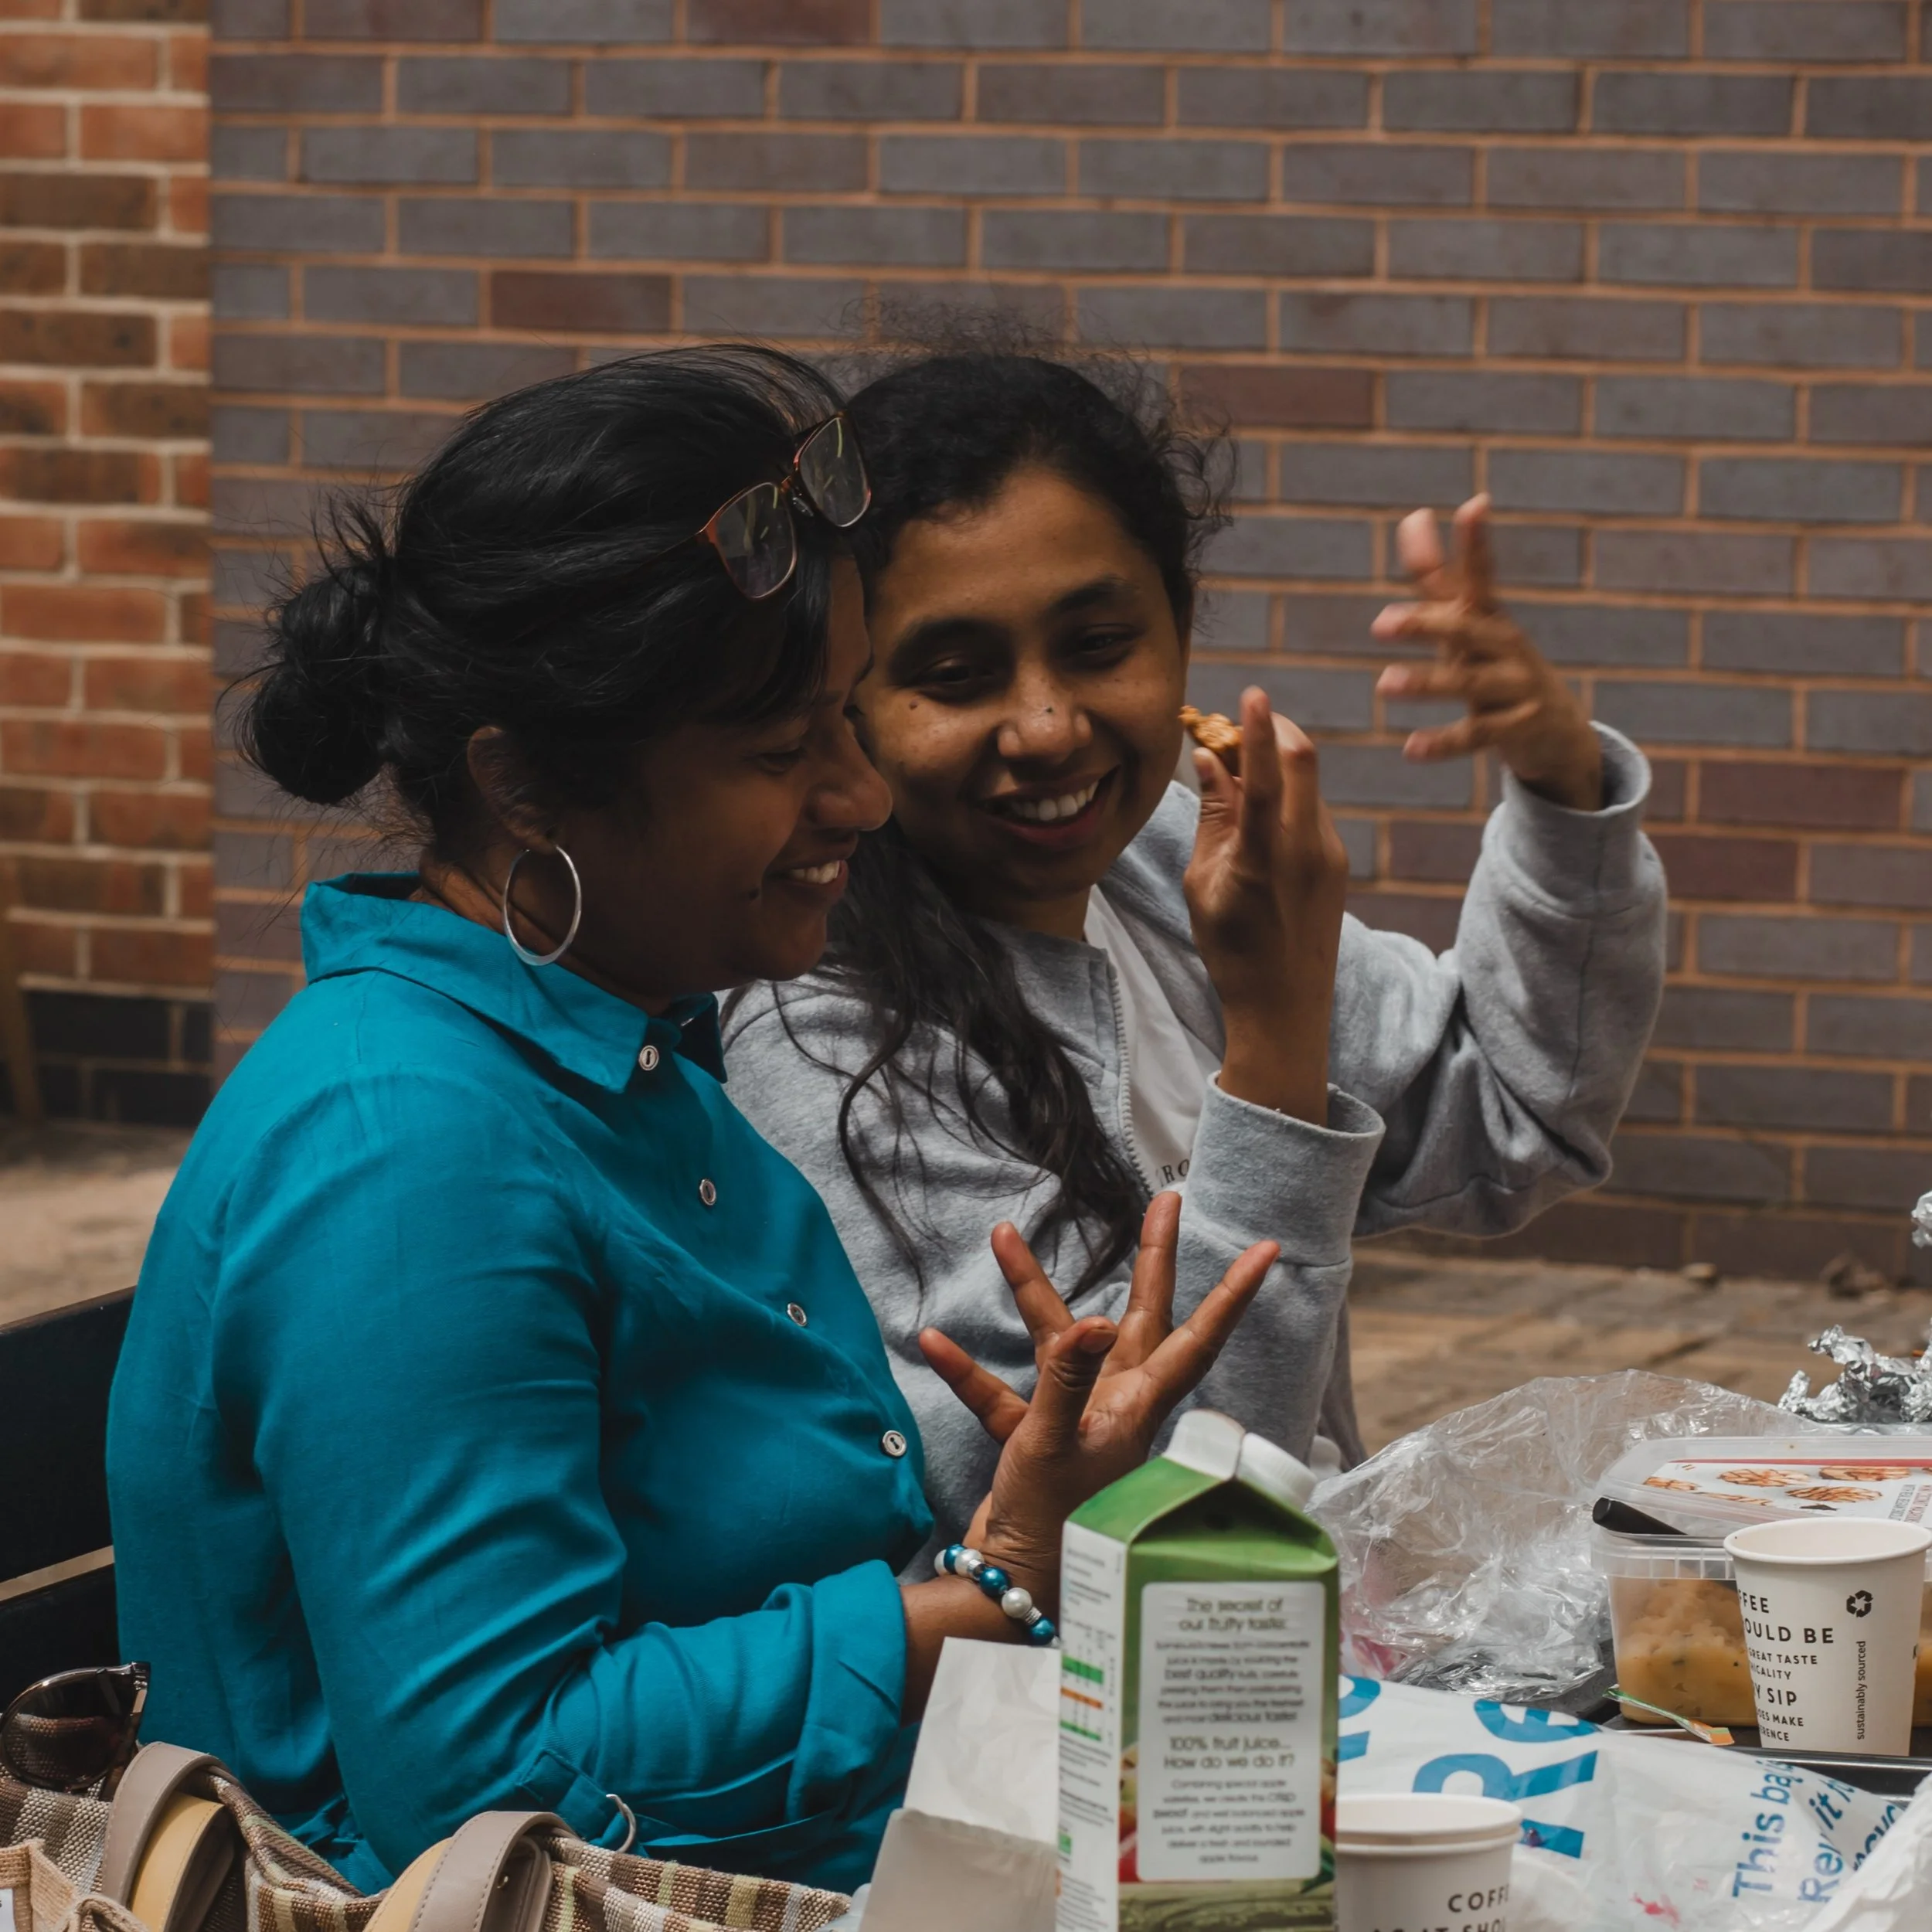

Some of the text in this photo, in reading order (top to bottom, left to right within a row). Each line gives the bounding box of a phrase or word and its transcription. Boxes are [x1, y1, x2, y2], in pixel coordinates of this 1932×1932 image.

[1160, 1159, 1190, 1188] RO
[1187, 1597, 1284, 1612] The secret of
[1179, 1619, 1203, 1631] our
[1208, 1617, 1244, 1632] fruity
[1804, 1628, 1834, 1644] BE
[1777, 1654, 1818, 1665] TASTE
[1195, 1668, 1235, 1680] quality
[1767, 1687, 1798, 1706] SIP
[1855, 1641, 1868, 1740] sustainably sourced
[1772, 1714, 1804, 1726] MAKE
[1169, 1736, 1208, 1751] 100%
[1213, 1736, 1240, 1750] fruit
[1163, 1753, 1295, 1769] How do we do it?
[1808, 1791, 1843, 1831] it
[1732, 1812, 1785, 1898] This
